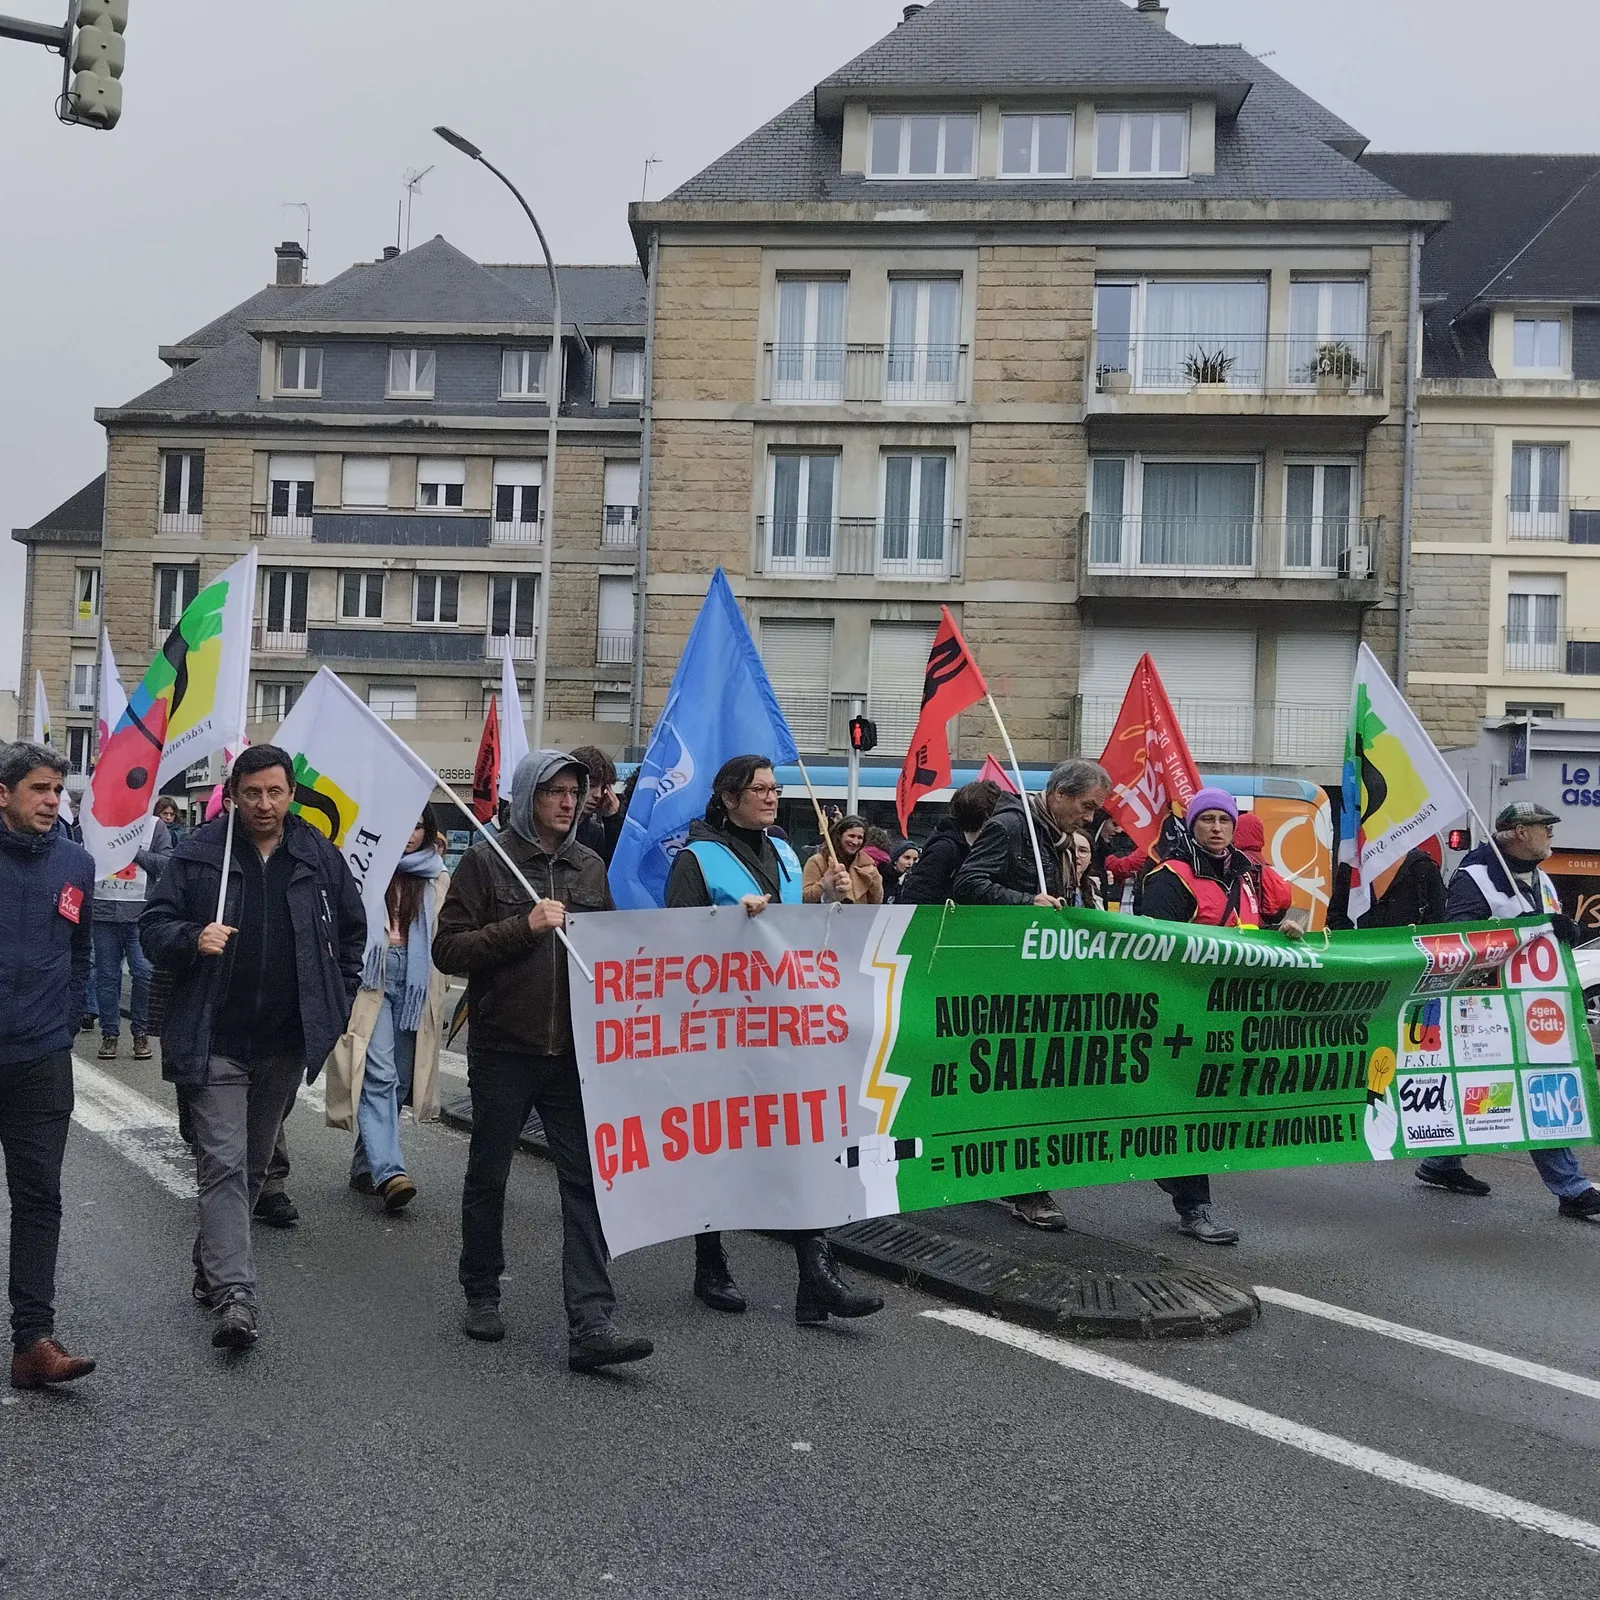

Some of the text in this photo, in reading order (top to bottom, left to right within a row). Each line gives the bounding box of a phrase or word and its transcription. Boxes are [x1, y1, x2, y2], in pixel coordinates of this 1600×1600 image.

[1562, 763, 1590, 786] Le
[101, 880, 134, 891] F.S.U.
[1021, 921, 1324, 969] ÉDUCATION NATIONALE
[1438, 947, 1466, 973] cgt
[1511, 935, 1558, 984] FO
[594, 946, 841, 1005] RÉFORMES
[1207, 974, 1391, 1013] AMÉLIORATION
[595, 995, 849, 1064] DÉLÉTÈRES
[936, 991, 1160, 1038] AUGMENTATIONS
[1531, 1007, 1556, 1017] sgen
[1205, 1013, 1371, 1053] DES CONDITIONS
[930, 1033, 1153, 1097] DE SALAIRES
[1196, 1051, 1368, 1098] DE TRAVAIL
[1404, 1054, 1442, 1068] F.S.U.
[1415, 1077, 1438, 1085] éducation
[1400, 1074, 1447, 1113] Sud
[594, 1085, 848, 1191] ÇA SUFFIT !
[951, 1139, 1008, 1179] TOUT
[1014, 1136, 1040, 1170] DE
[1046, 1130, 1114, 1167] SUITE,
[1120, 1124, 1177, 1160] POUR
[1184, 1121, 1241, 1154] TOUT
[1245, 1119, 1268, 1149] LE
[1272, 1114, 1344, 1149] MONDE
[1348, 1113, 1357, 1142] !
[1407, 1124, 1455, 1140] Solidaires
